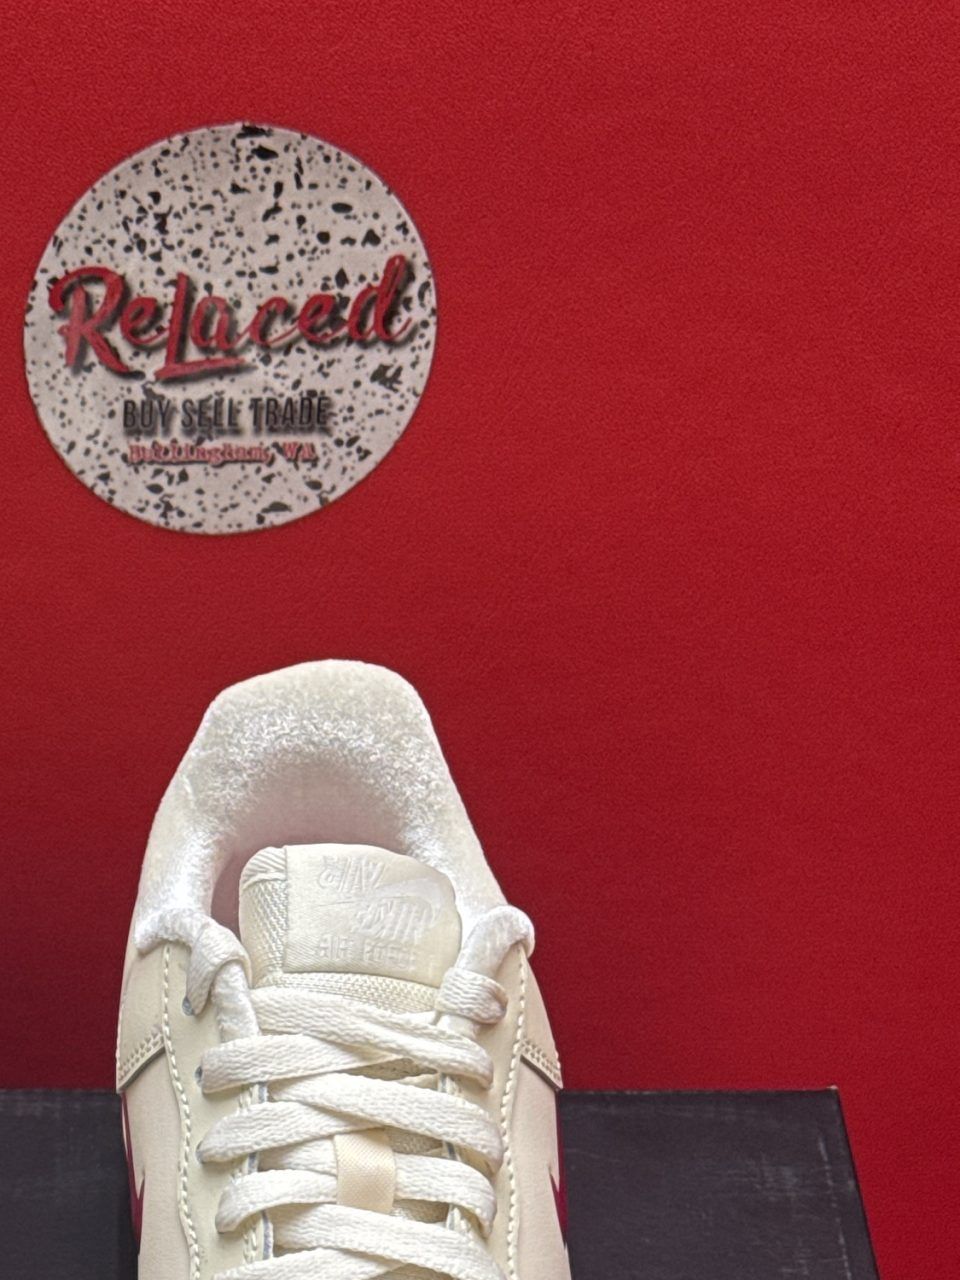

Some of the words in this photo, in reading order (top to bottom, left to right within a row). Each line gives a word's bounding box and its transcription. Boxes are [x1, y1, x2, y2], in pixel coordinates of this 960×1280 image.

[48, 254, 415, 381] ReLaced
[123, 399, 170, 431] BUY
[181, 398, 240, 430] SELL
[249, 396, 330, 429] TRADE
